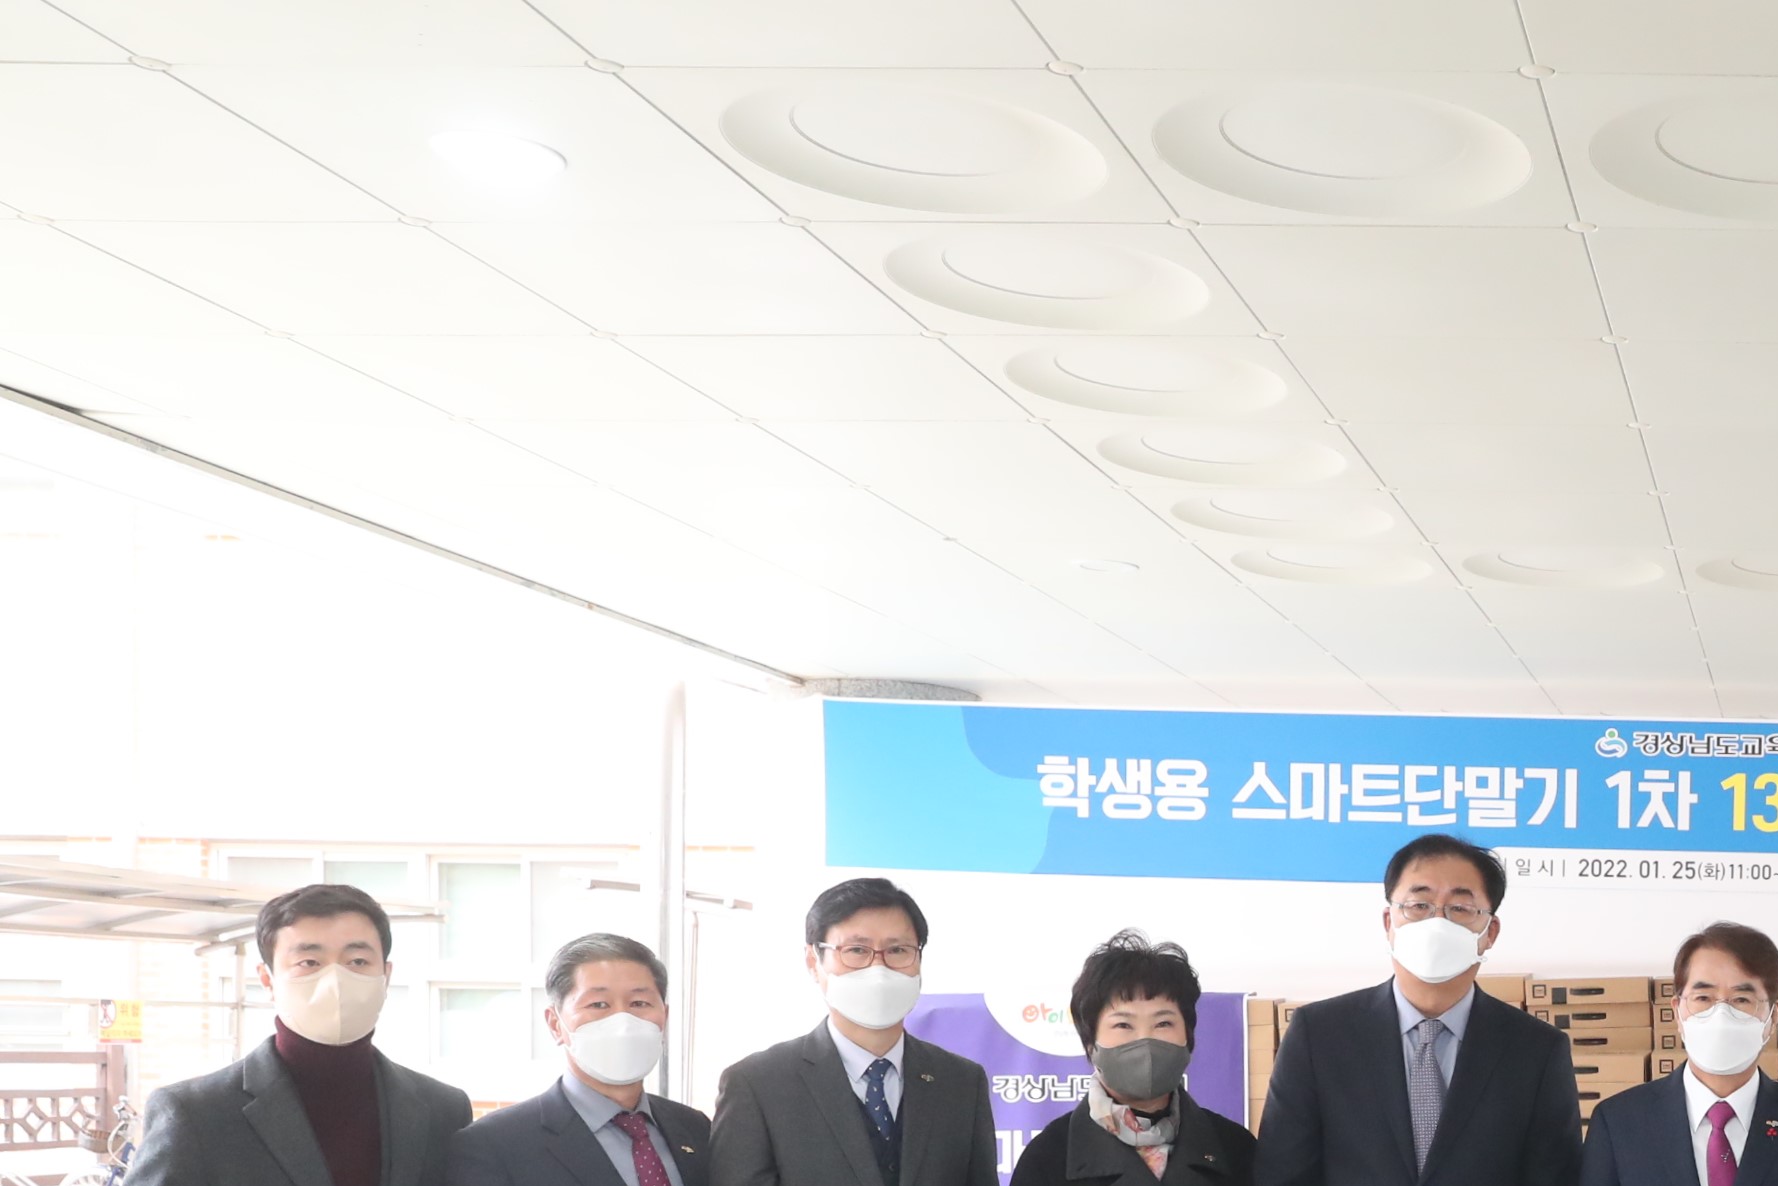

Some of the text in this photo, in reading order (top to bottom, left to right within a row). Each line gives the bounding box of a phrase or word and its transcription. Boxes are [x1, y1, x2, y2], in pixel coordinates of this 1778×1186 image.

[1037, 755, 1209, 821] 학생용
[1231, 761, 1578, 829] 스마트단말기
[1604, 769, 1699, 831] 1차
